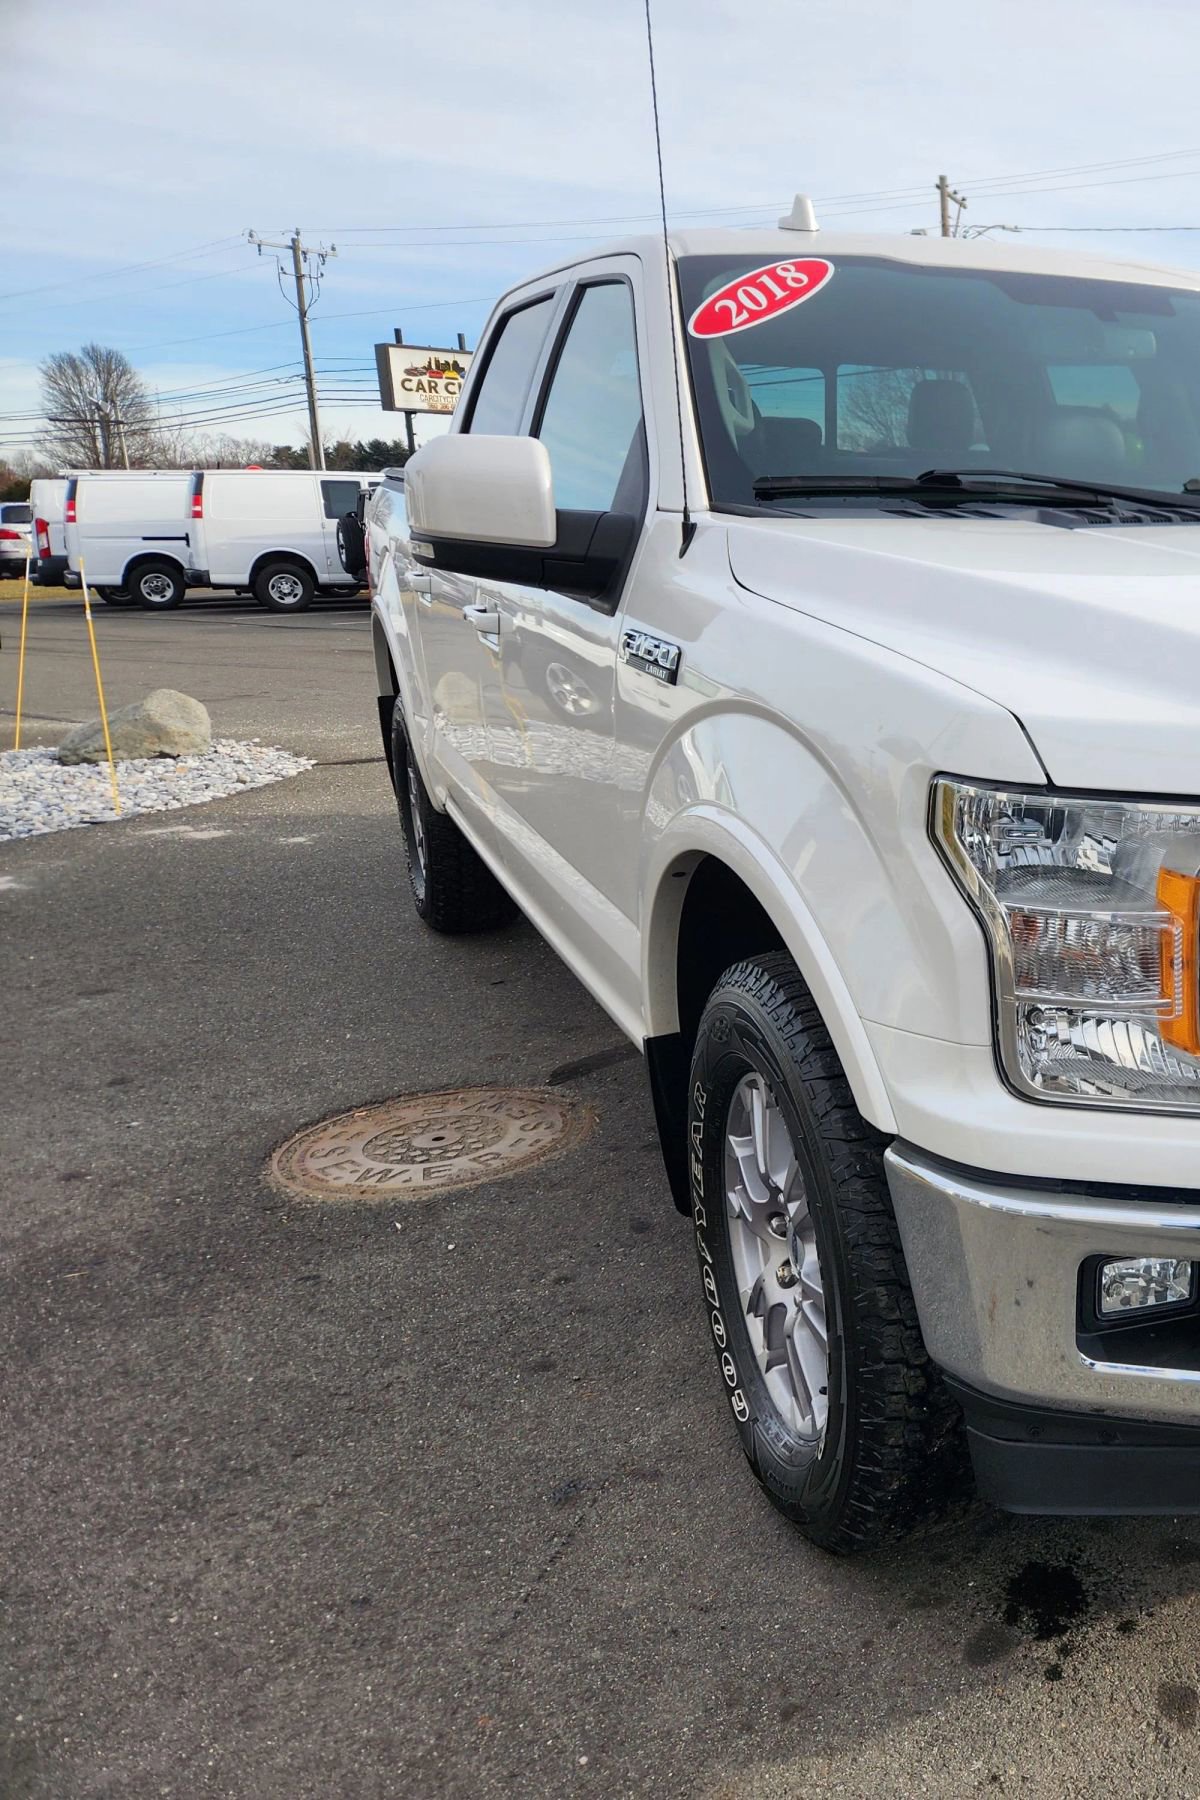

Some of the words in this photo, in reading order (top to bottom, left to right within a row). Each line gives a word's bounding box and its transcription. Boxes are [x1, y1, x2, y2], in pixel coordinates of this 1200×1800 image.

[715, 263, 809, 327] 2018
[401, 378, 439, 394] CAR
[645, 664, 666, 679] LARIAT
[310, 1146, 513, 1182] SEWER
